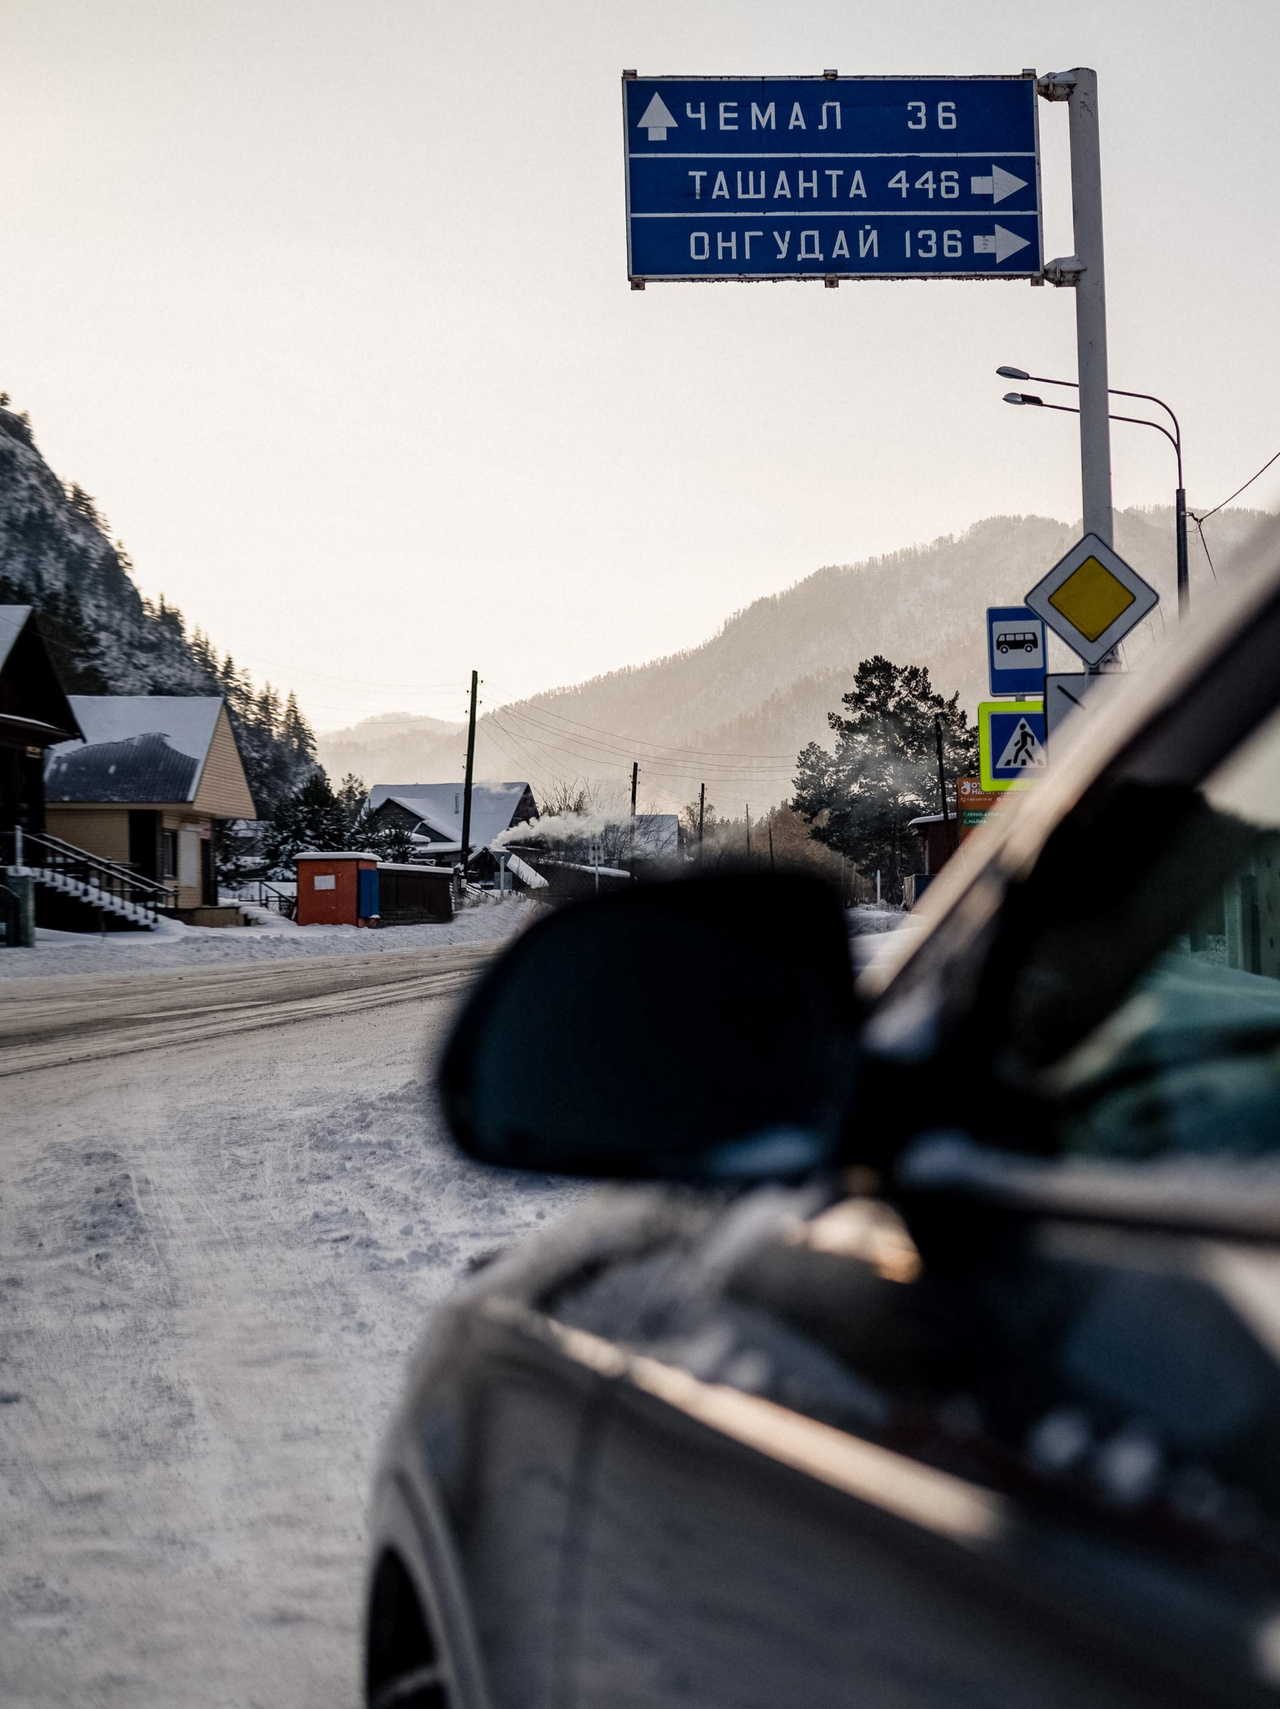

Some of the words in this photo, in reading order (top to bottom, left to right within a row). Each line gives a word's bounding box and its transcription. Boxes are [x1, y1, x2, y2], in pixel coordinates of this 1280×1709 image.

[686, 101, 842, 130] ЧЕМАЛ
[907, 101, 957, 130] 36
[688, 170, 867, 199] ТАШАНТА
[887, 170, 959, 199] 446
[690, 225, 879, 261] ОНГУДАЙ
[905, 229, 962, 258] 136
